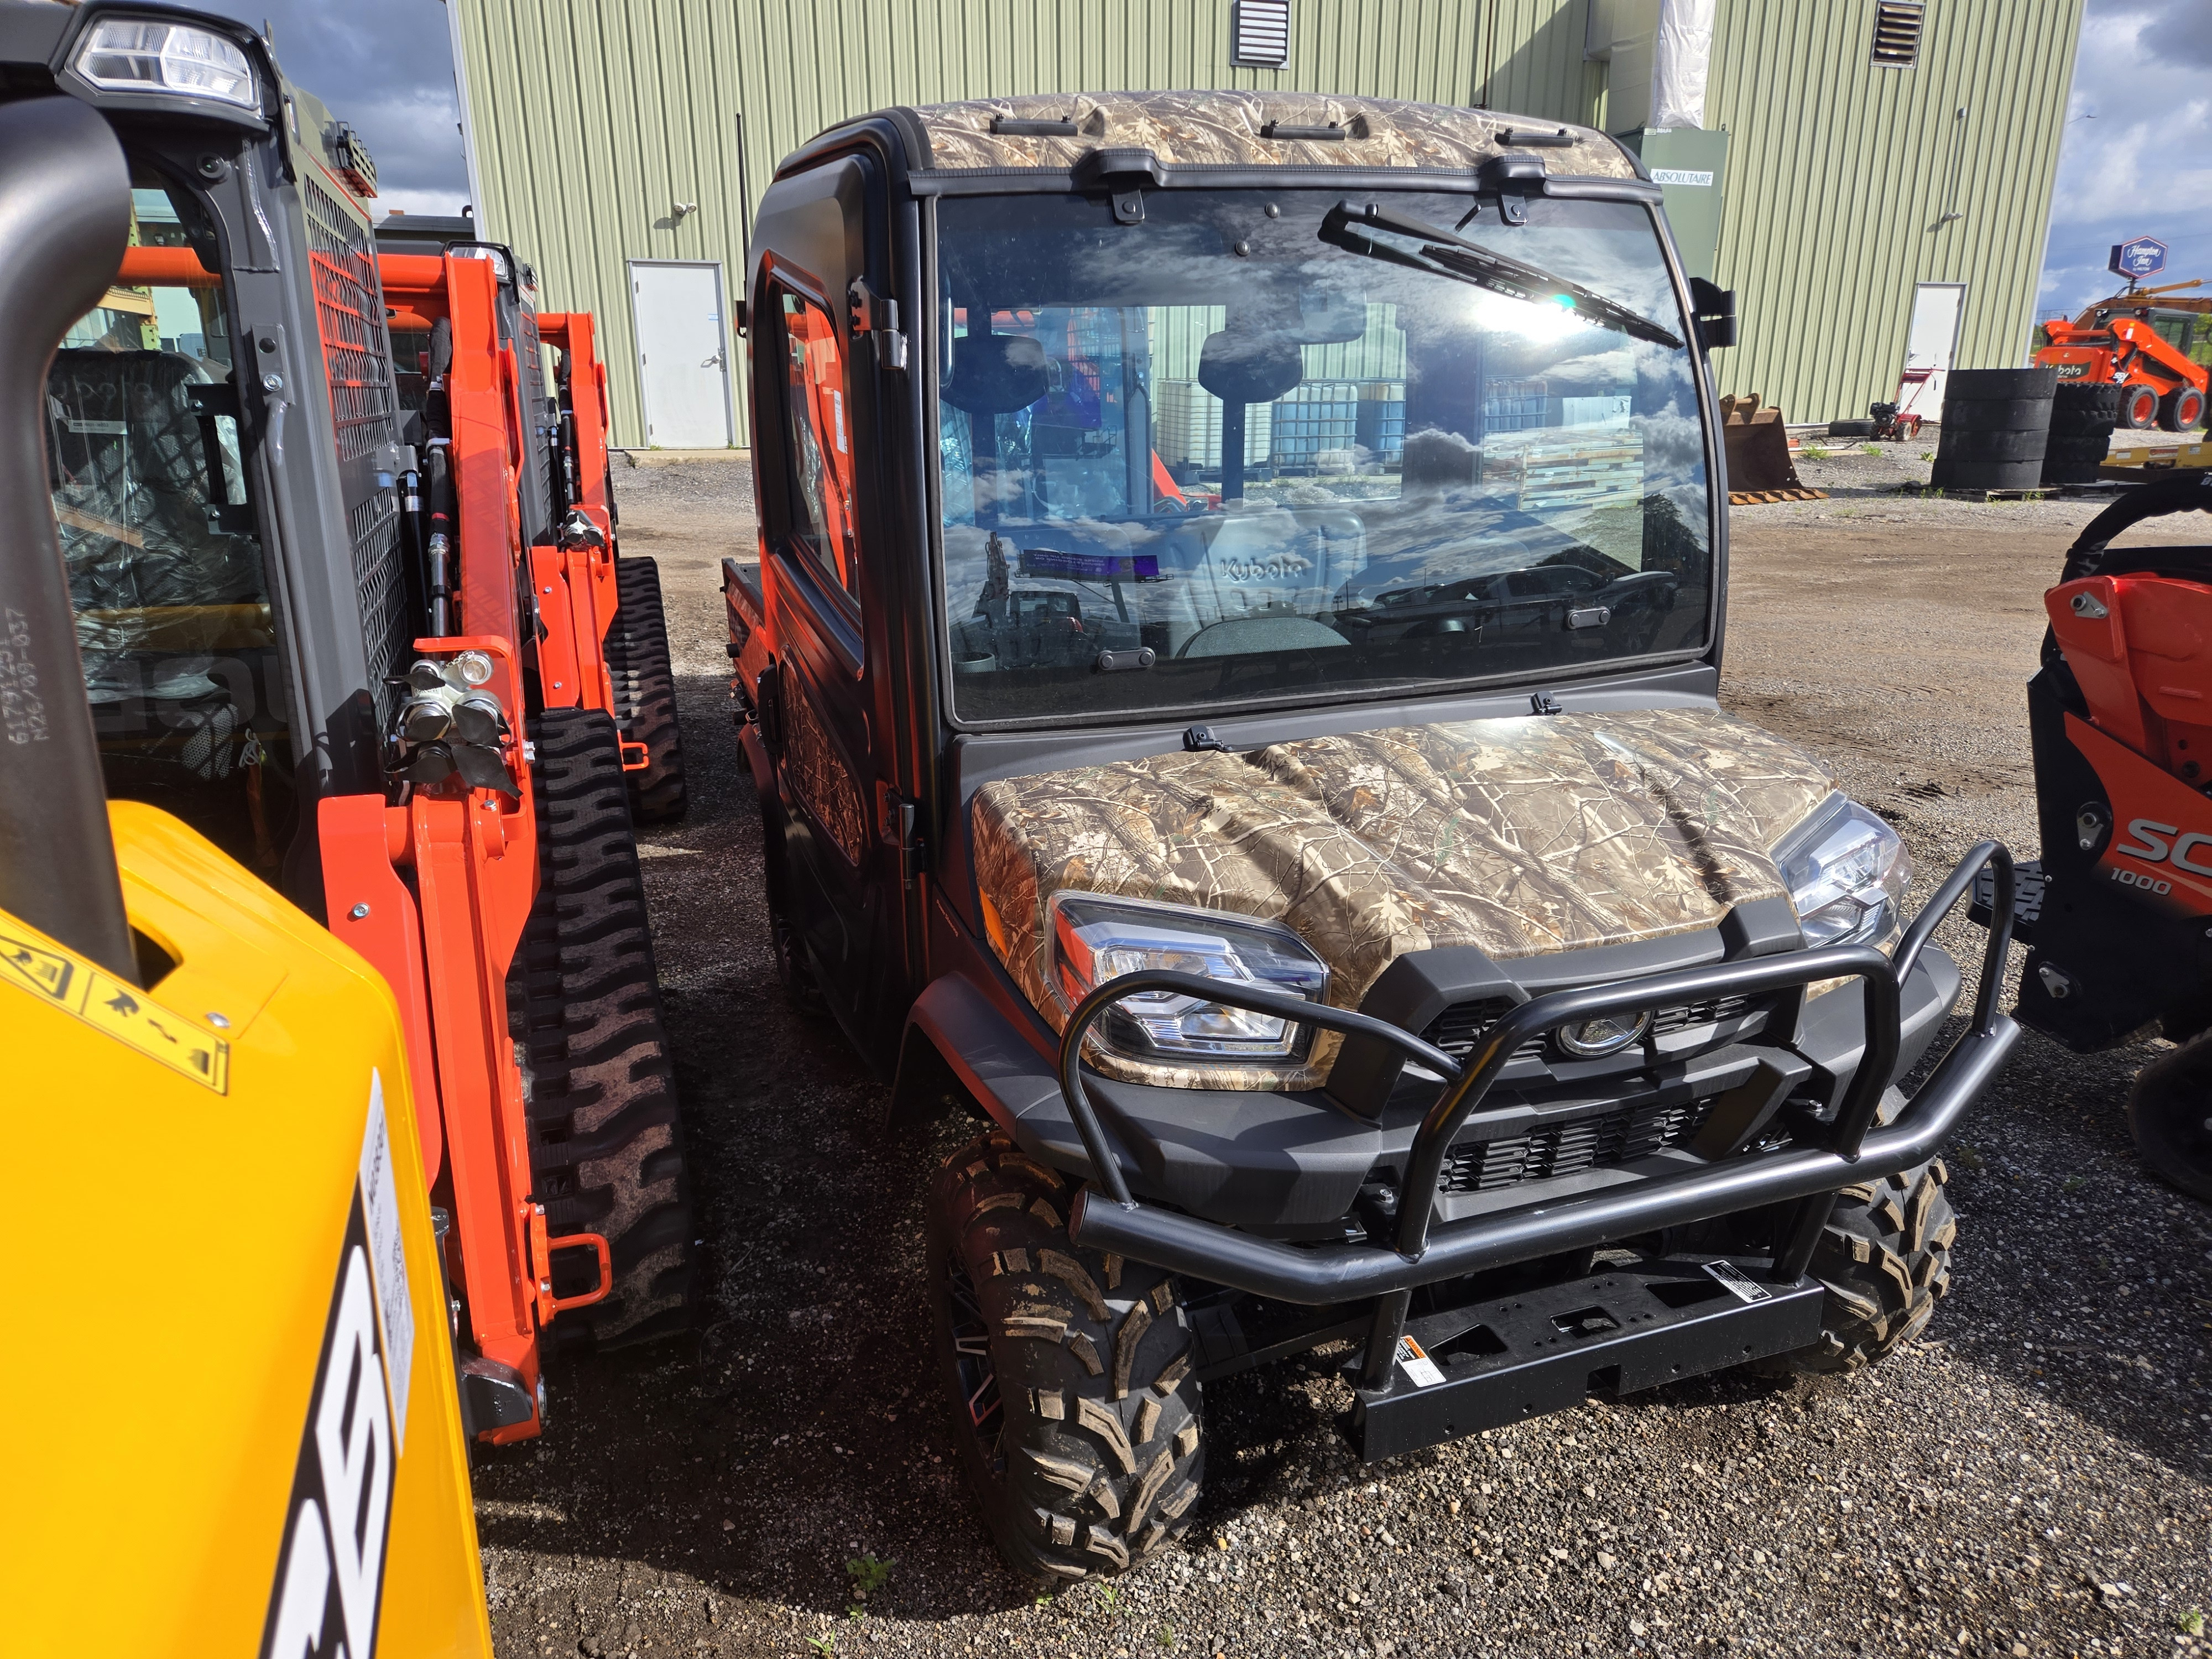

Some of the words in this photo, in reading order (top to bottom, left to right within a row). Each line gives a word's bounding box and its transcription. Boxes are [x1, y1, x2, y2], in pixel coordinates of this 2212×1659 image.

[1652, 171, 1712, 184] ABSOLUTAIRE
[2127, 245, 2161, 258] Hampton
[2133, 255, 2152, 267] Inn
[2045, 364, 2081, 375] bota
[1220, 555, 1307, 583] Kubota
[2111, 867, 2172, 895] 1000
[1409, 1339, 1426, 1359] WARNING
